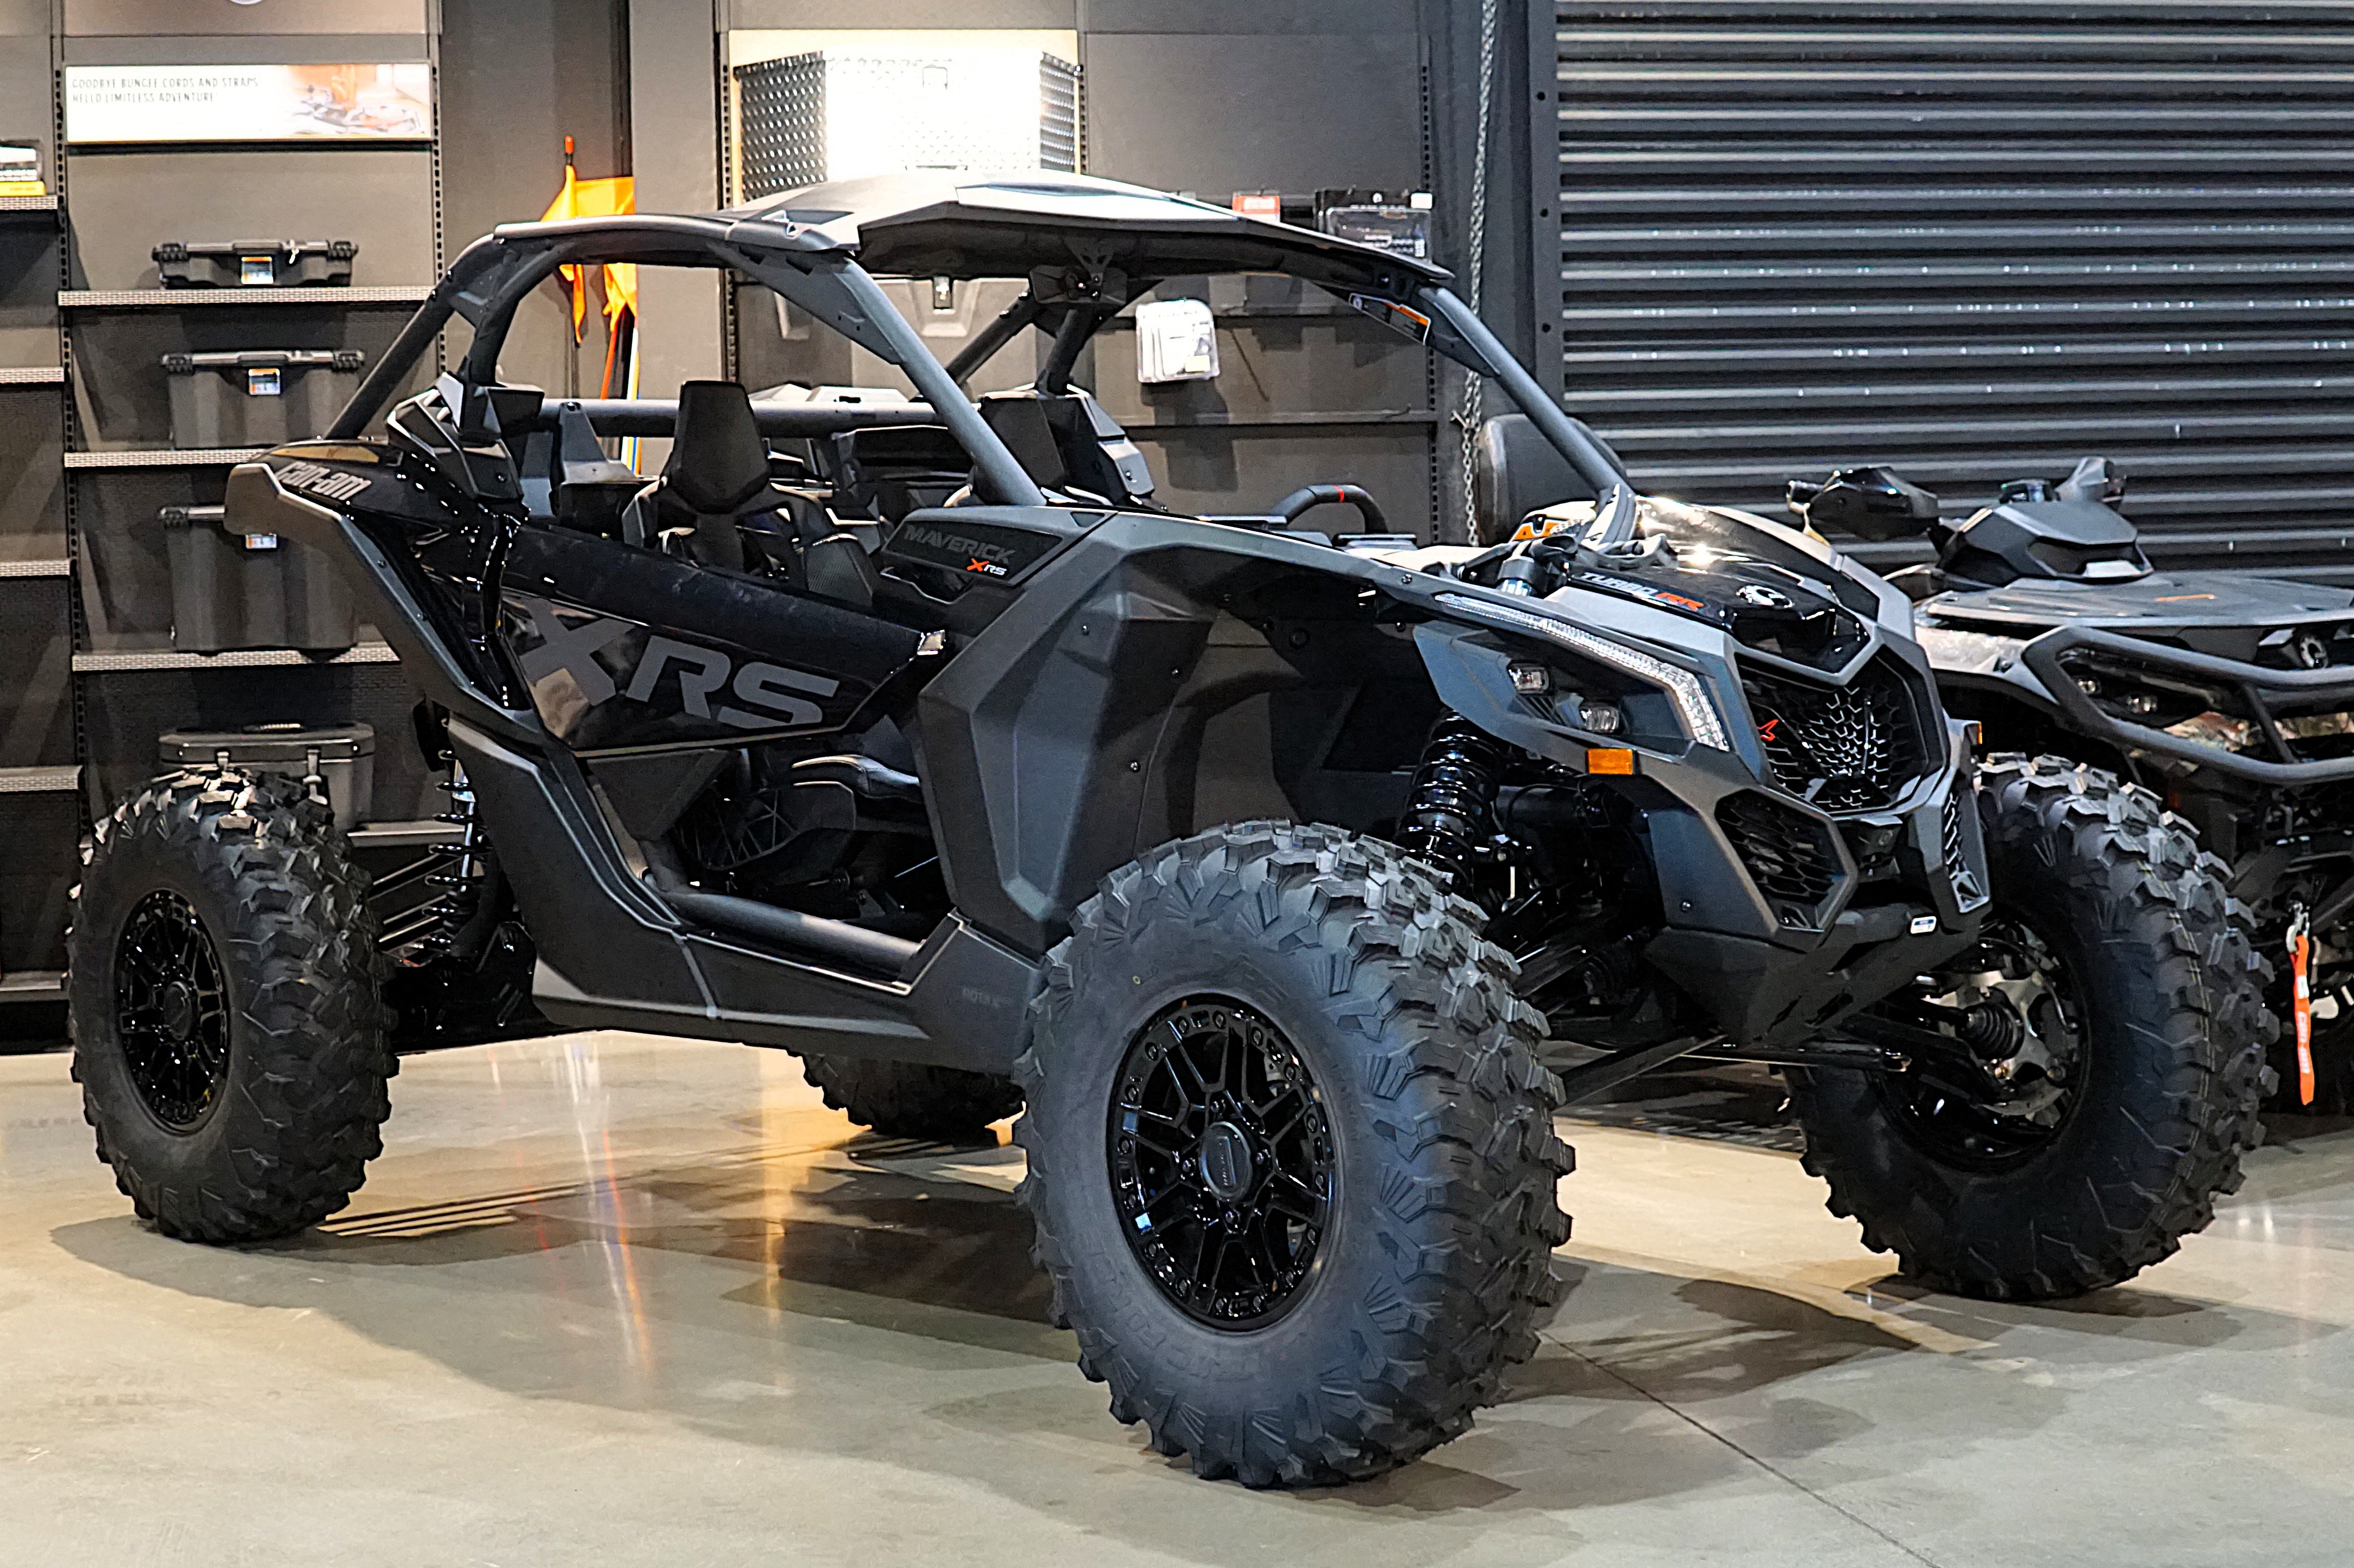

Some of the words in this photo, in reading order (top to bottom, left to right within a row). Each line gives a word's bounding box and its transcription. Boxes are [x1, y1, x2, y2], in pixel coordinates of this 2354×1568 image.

[199, 78, 218, 88] AND
[904, 524, 1017, 564] MAVERICK
[1581, 572, 1658, 597] TURBO
[518, 598, 840, 729] XRS
